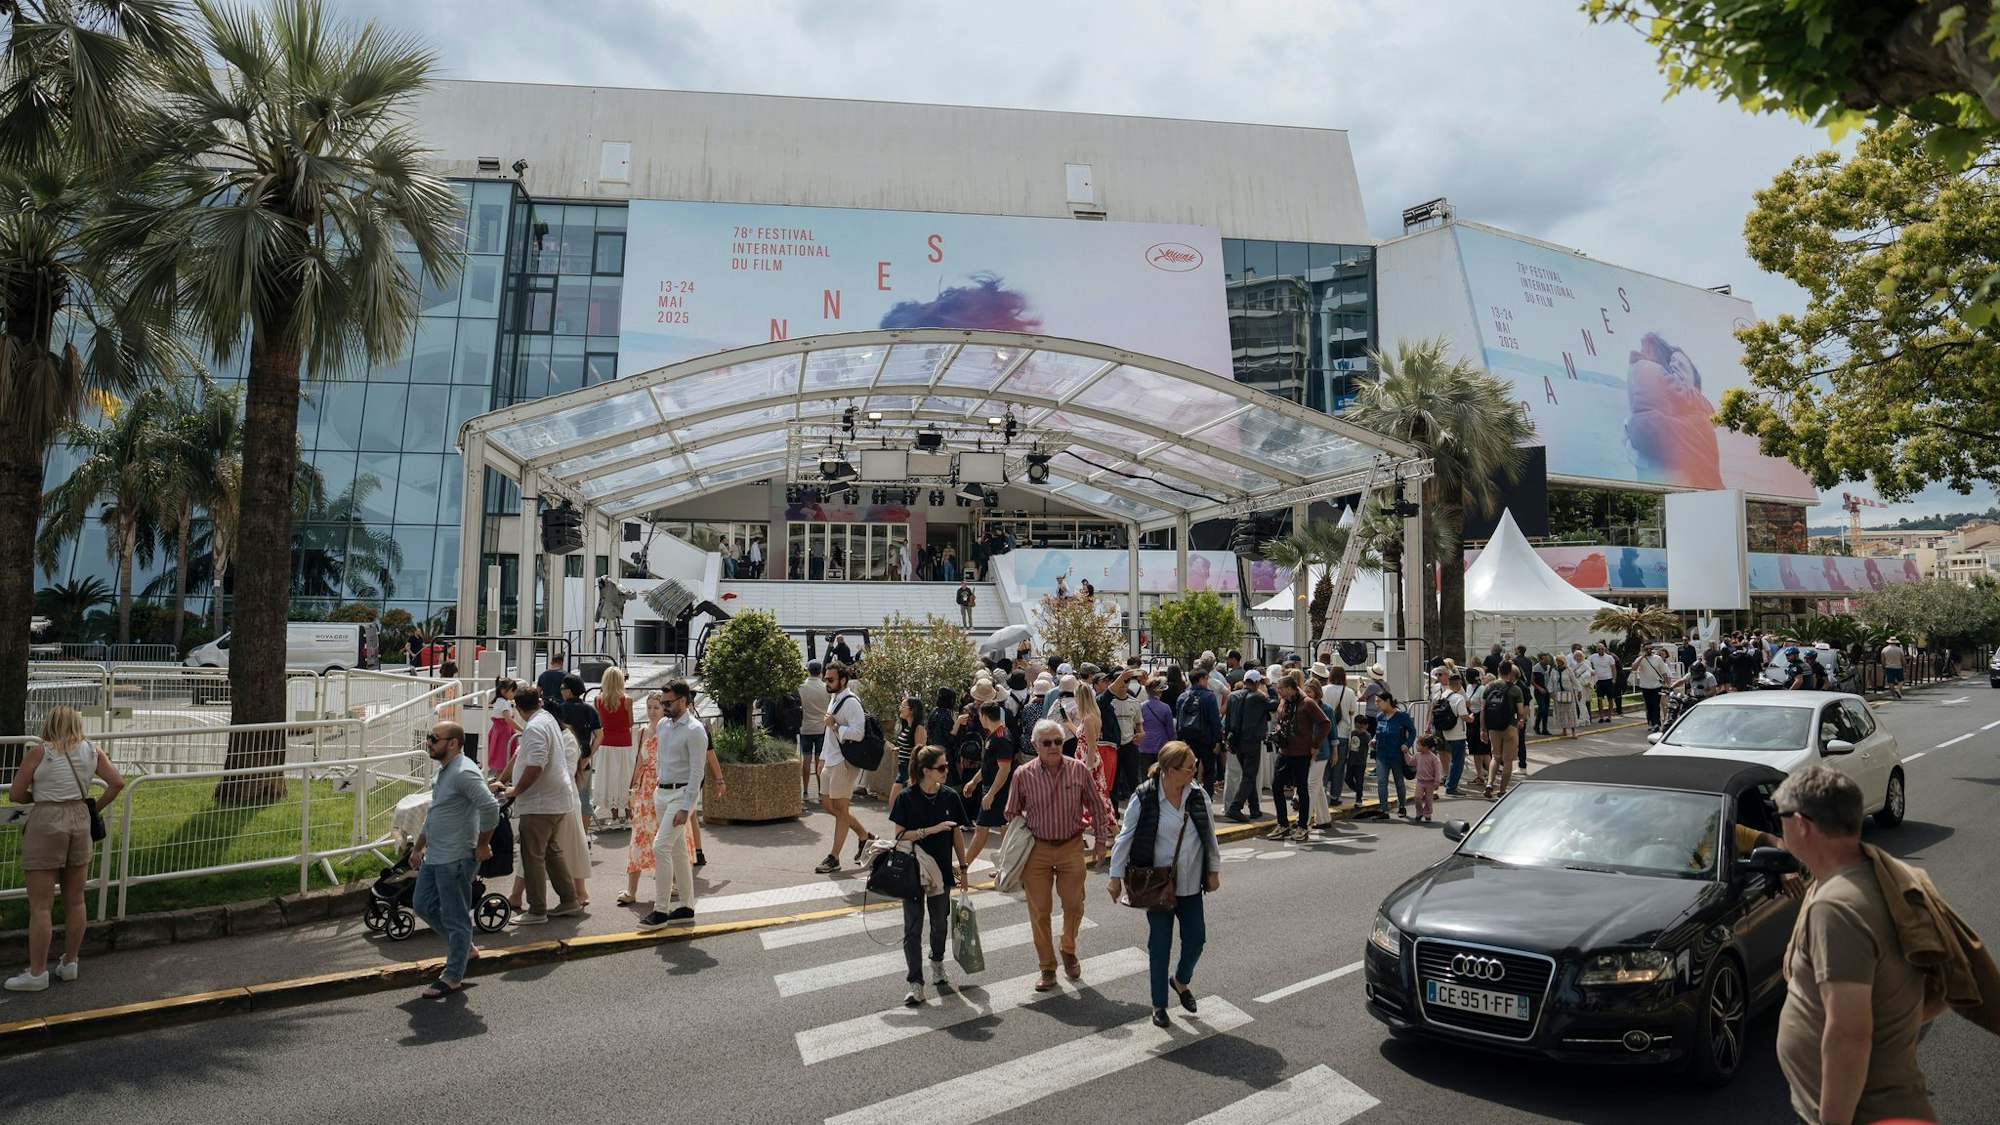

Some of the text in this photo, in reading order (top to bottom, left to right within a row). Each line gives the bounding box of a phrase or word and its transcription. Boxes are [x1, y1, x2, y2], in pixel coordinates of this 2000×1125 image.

[758, 228, 814, 241] FESTIVAL
[733, 243, 831, 257] INTERNATIONAL
[732, 258, 782, 271] DU FILM
[1529, 266, 1562, 283] FESTIVAL
[660, 280, 694, 293] 13-24
[1520, 277, 1575, 299] INTERNATIONAL
[658, 296, 682, 308] MAI
[1524, 292, 1553, 307] DU FILM
[658, 311, 689, 324] 2025
[1491, 306, 1513, 320] 13-24
[1495, 320, 1511, 334] MAI
[1499, 335, 1519, 350] 2025
